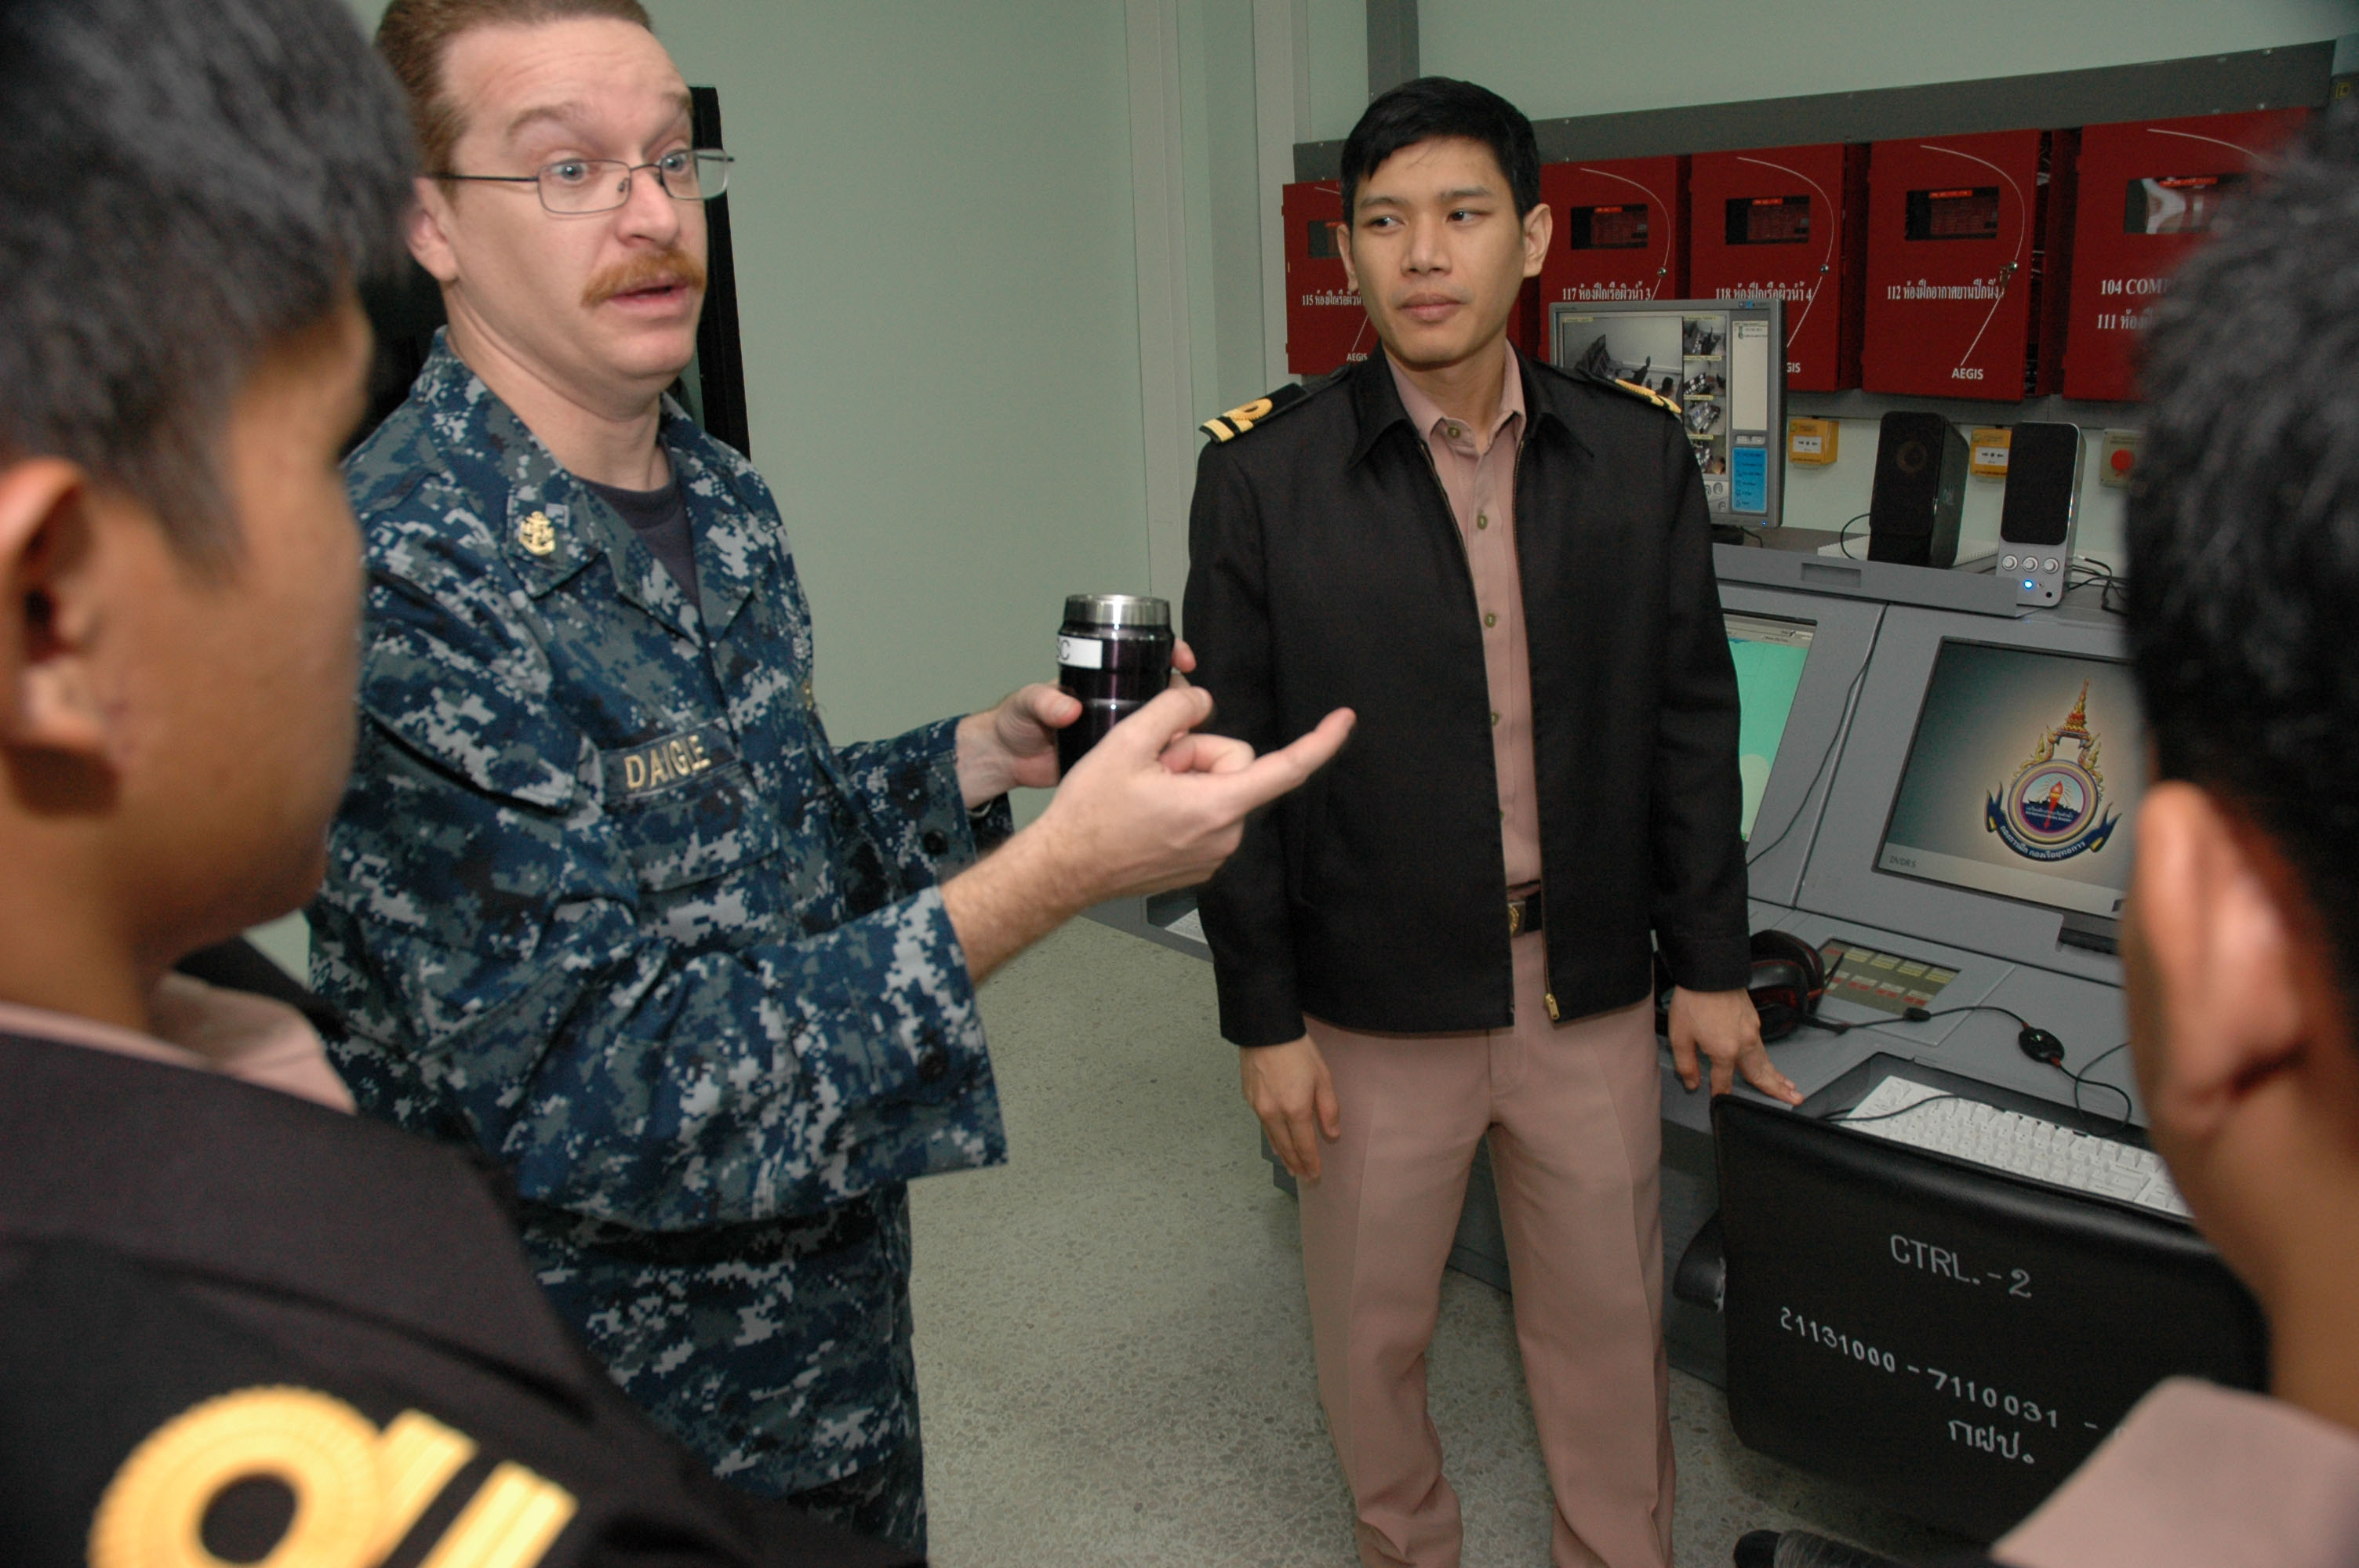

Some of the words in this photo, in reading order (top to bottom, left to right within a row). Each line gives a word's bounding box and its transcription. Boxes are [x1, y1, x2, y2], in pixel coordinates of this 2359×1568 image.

[1887, 285, 1902, 299] 112
[2101, 278, 2122, 295] 104
[1562, 288, 1576, 300] 117
[1715, 288, 1731, 299] 118
[1806, 289, 1812, 301] 4
[2097, 314, 2116, 329] 111
[1346, 353, 1368, 361] AEGIS
[1787, 362, 1801, 372] GIS
[1951, 367, 1984, 380] AEGIS
